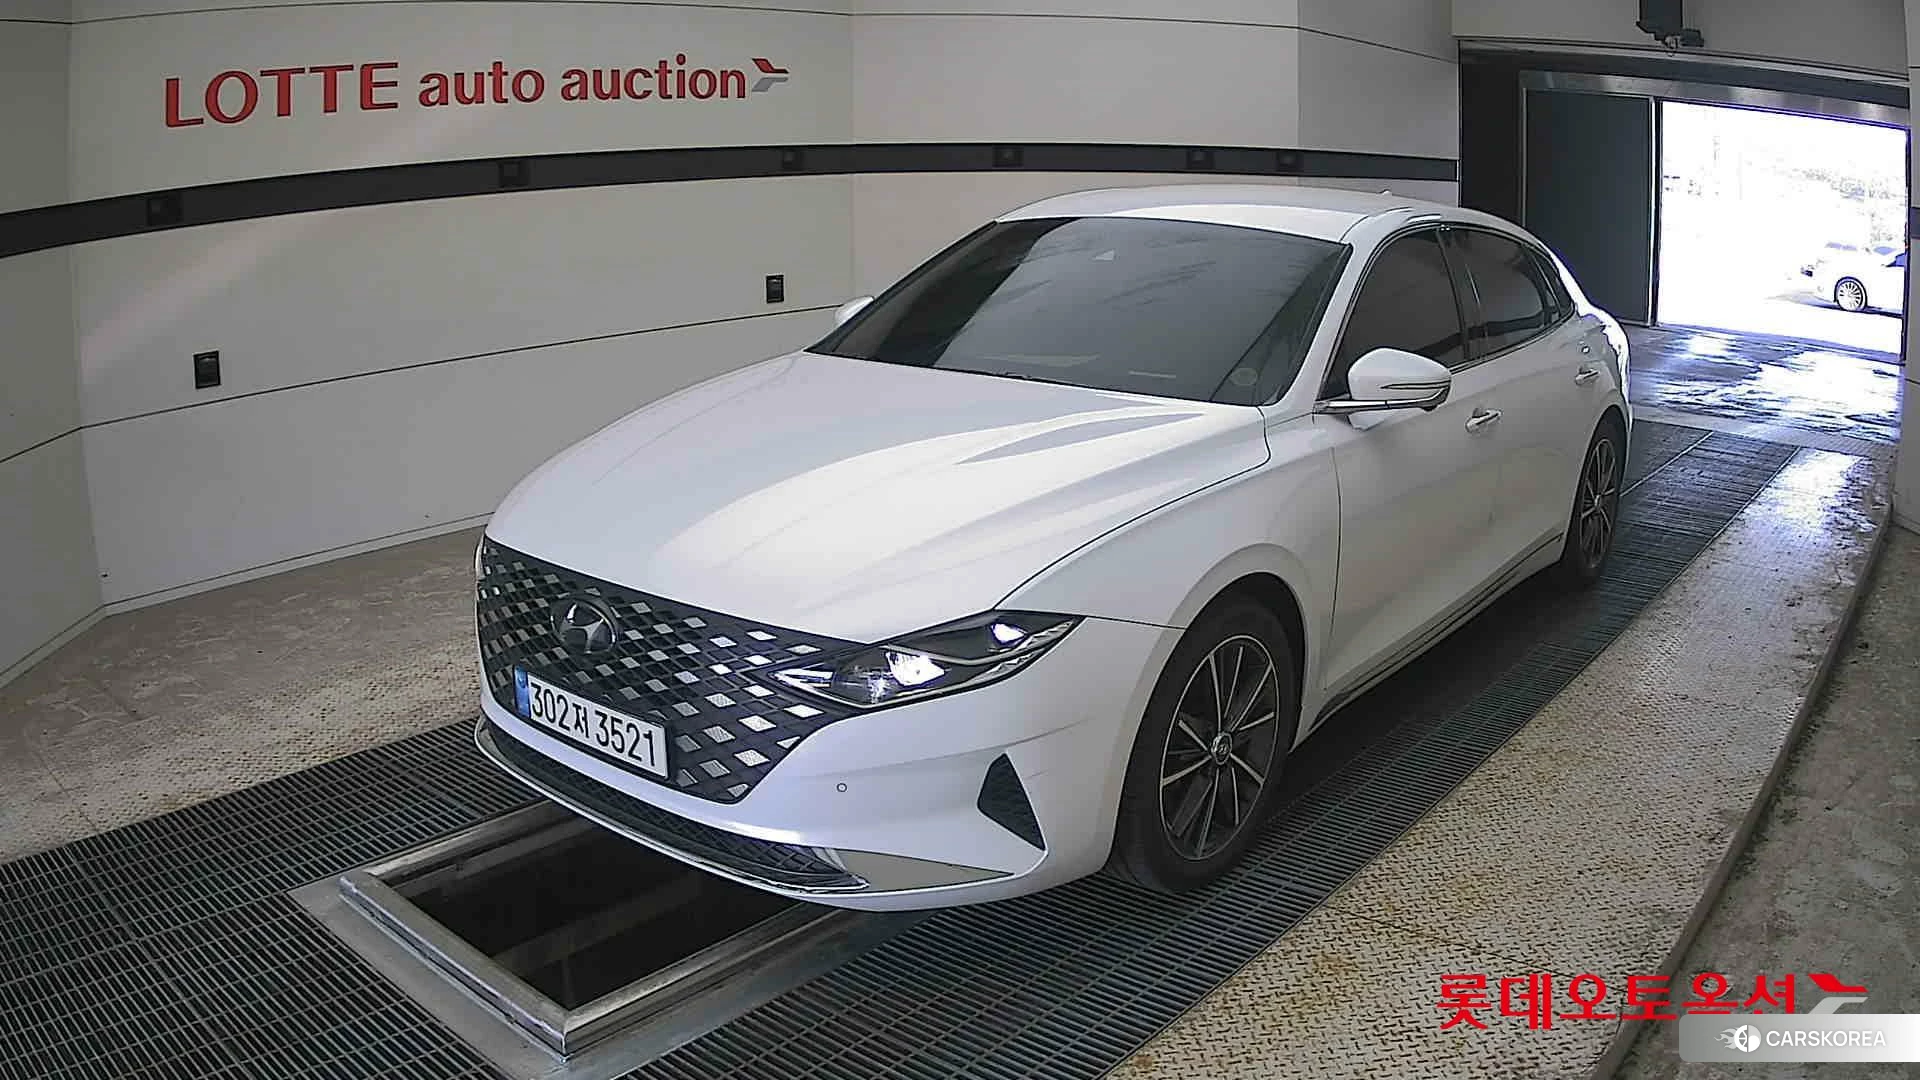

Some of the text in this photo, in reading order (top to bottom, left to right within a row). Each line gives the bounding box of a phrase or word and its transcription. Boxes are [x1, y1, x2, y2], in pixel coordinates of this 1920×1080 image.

[165, 53, 747, 128] LOTTE auto auction
[530, 682, 655, 767] 302저 3521
